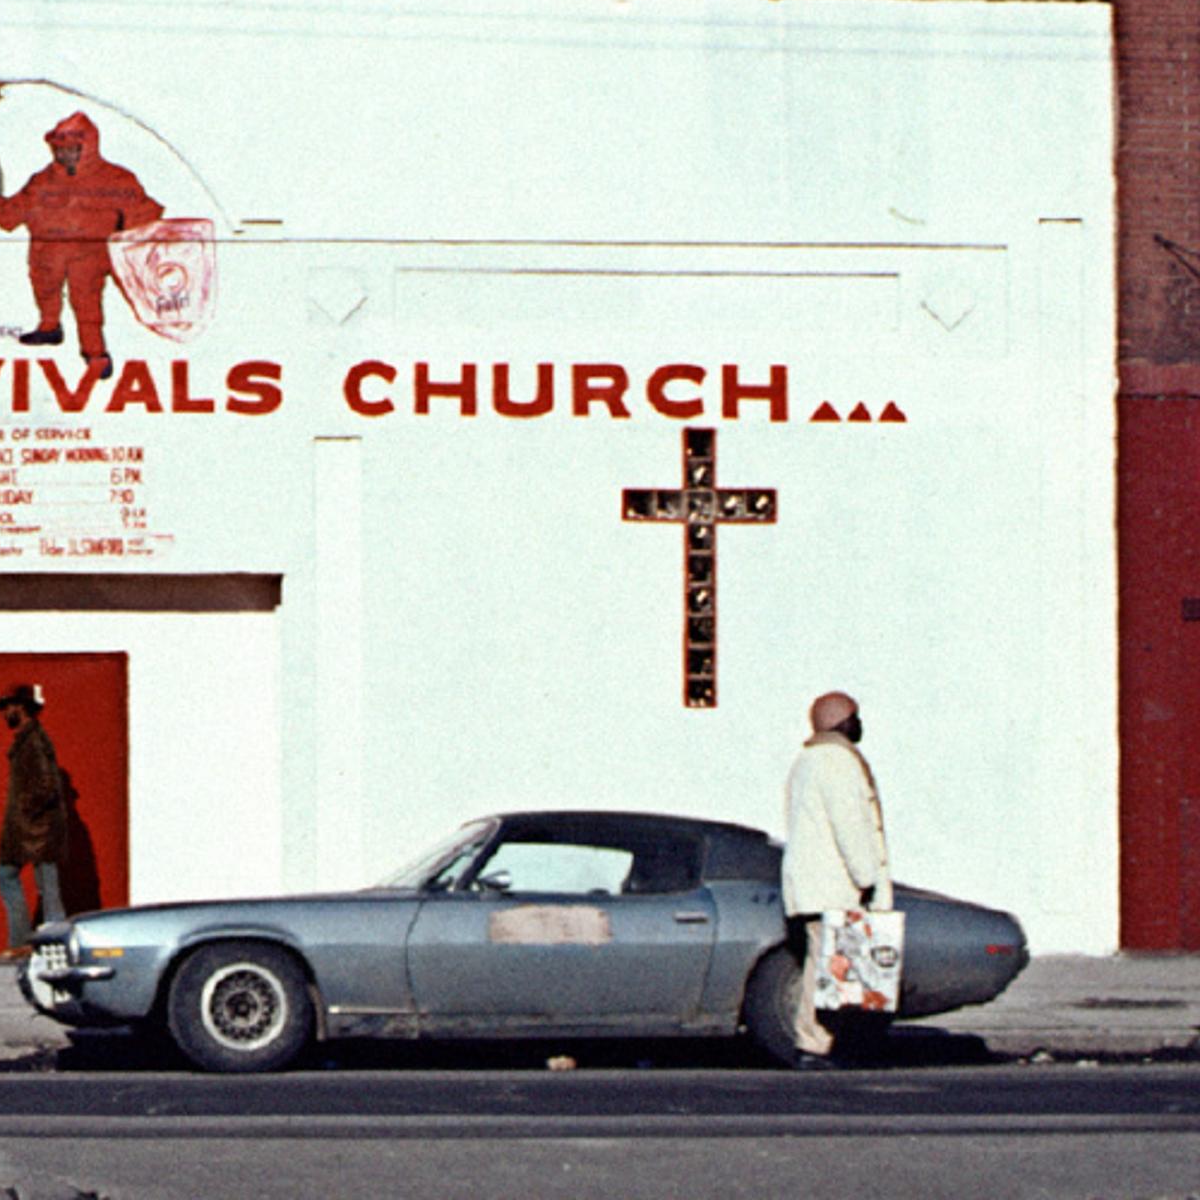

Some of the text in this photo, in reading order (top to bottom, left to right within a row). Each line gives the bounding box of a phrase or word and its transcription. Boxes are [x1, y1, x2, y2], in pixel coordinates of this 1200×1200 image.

[11, 428, 30, 441] OF
[34, 428, 92, 441] SERVICE
[21, 448, 62, 465] SUNDAY
